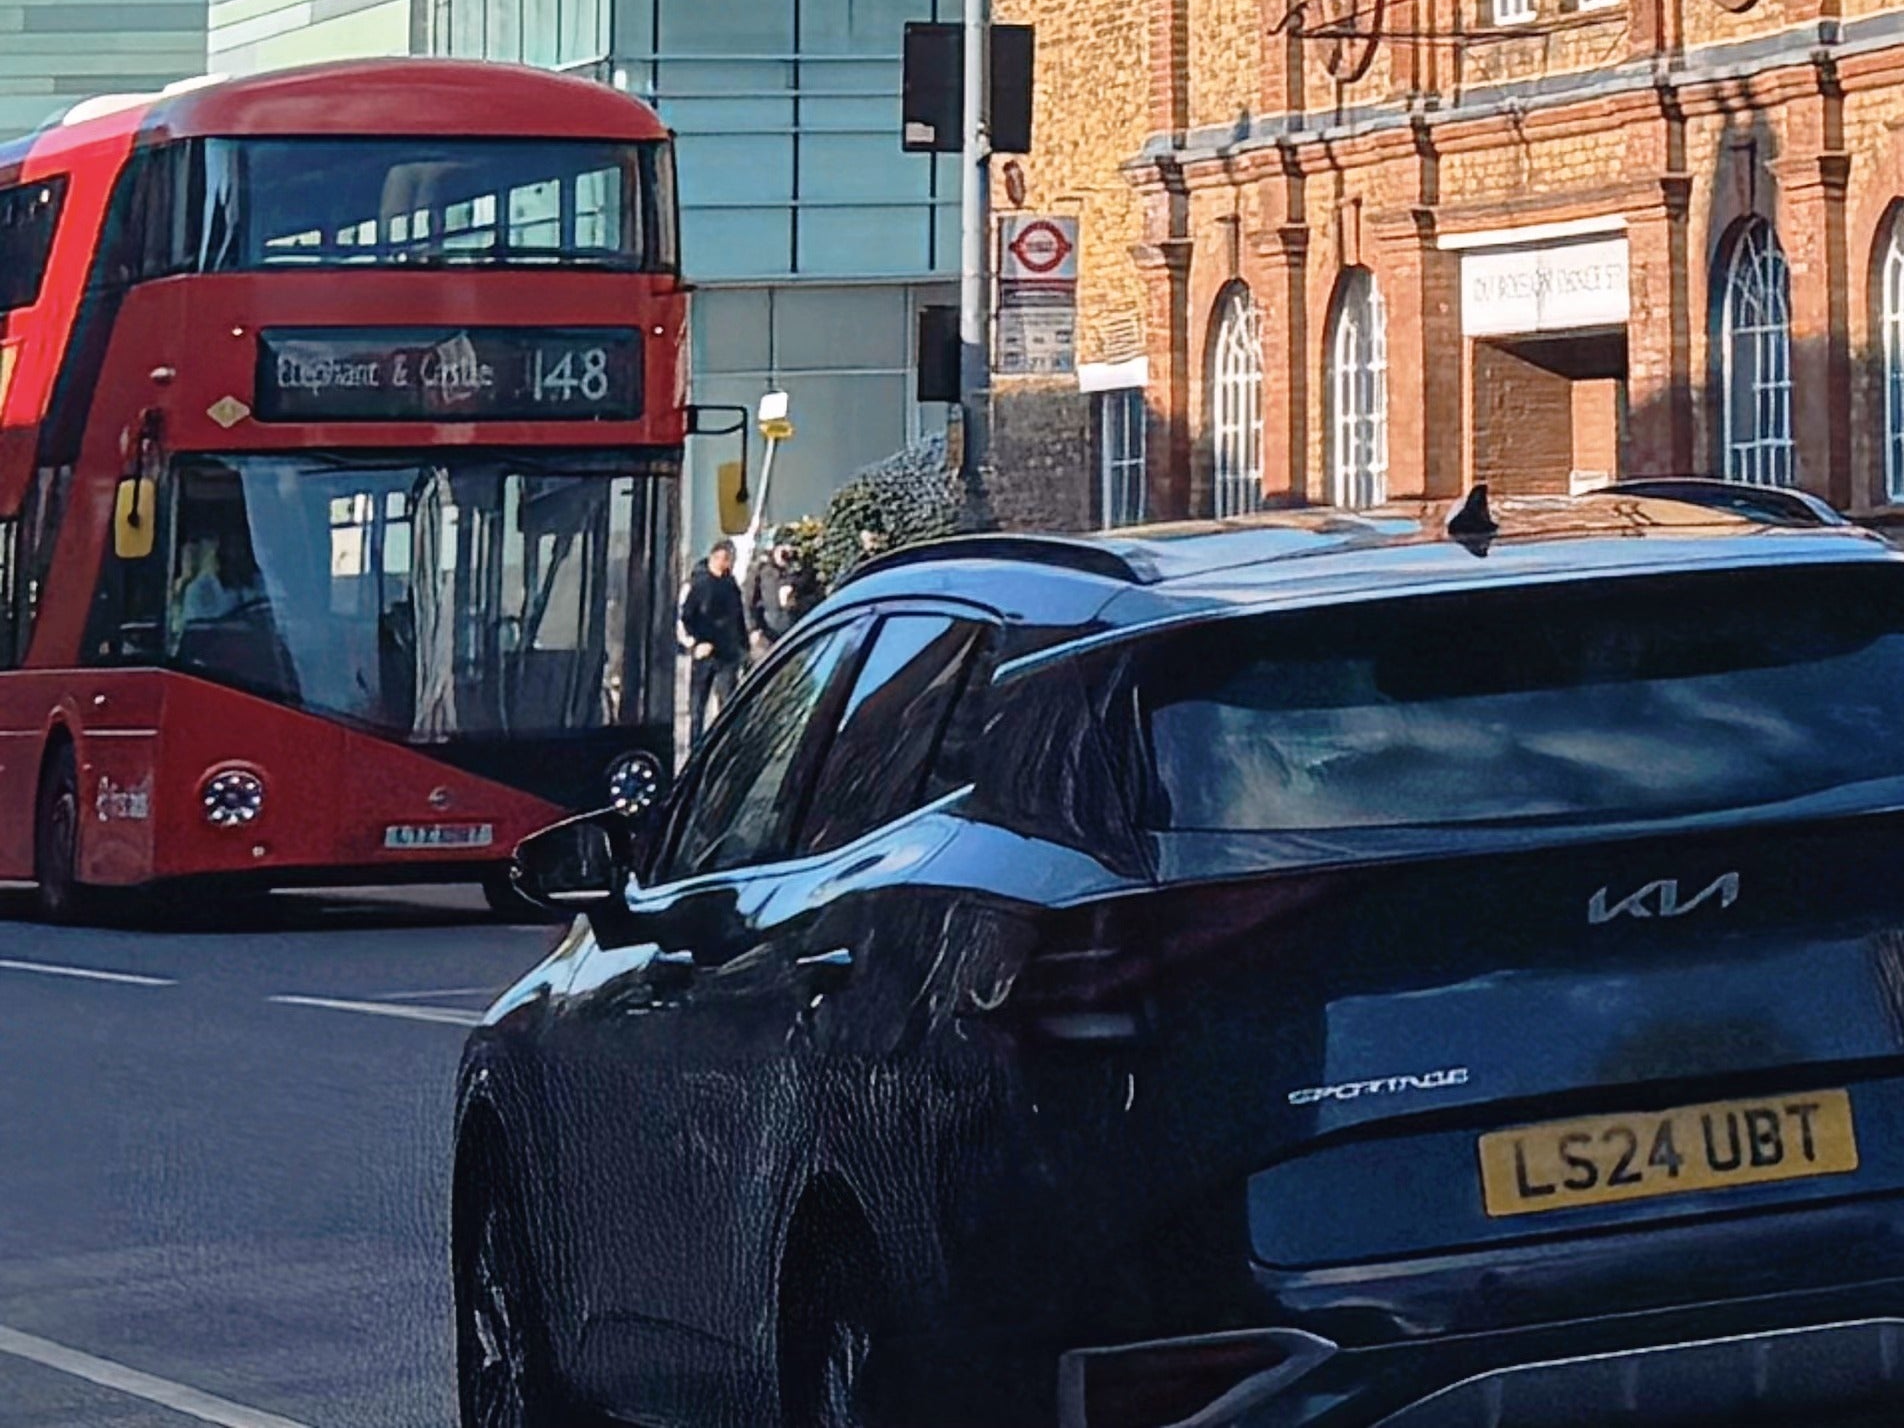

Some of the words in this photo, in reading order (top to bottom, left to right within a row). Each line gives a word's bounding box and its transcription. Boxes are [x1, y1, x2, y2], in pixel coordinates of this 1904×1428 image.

[531, 348, 608, 401] 148
[1513, 1118, 1684, 1199] LS24
[1700, 1102, 1819, 1173] UBT
